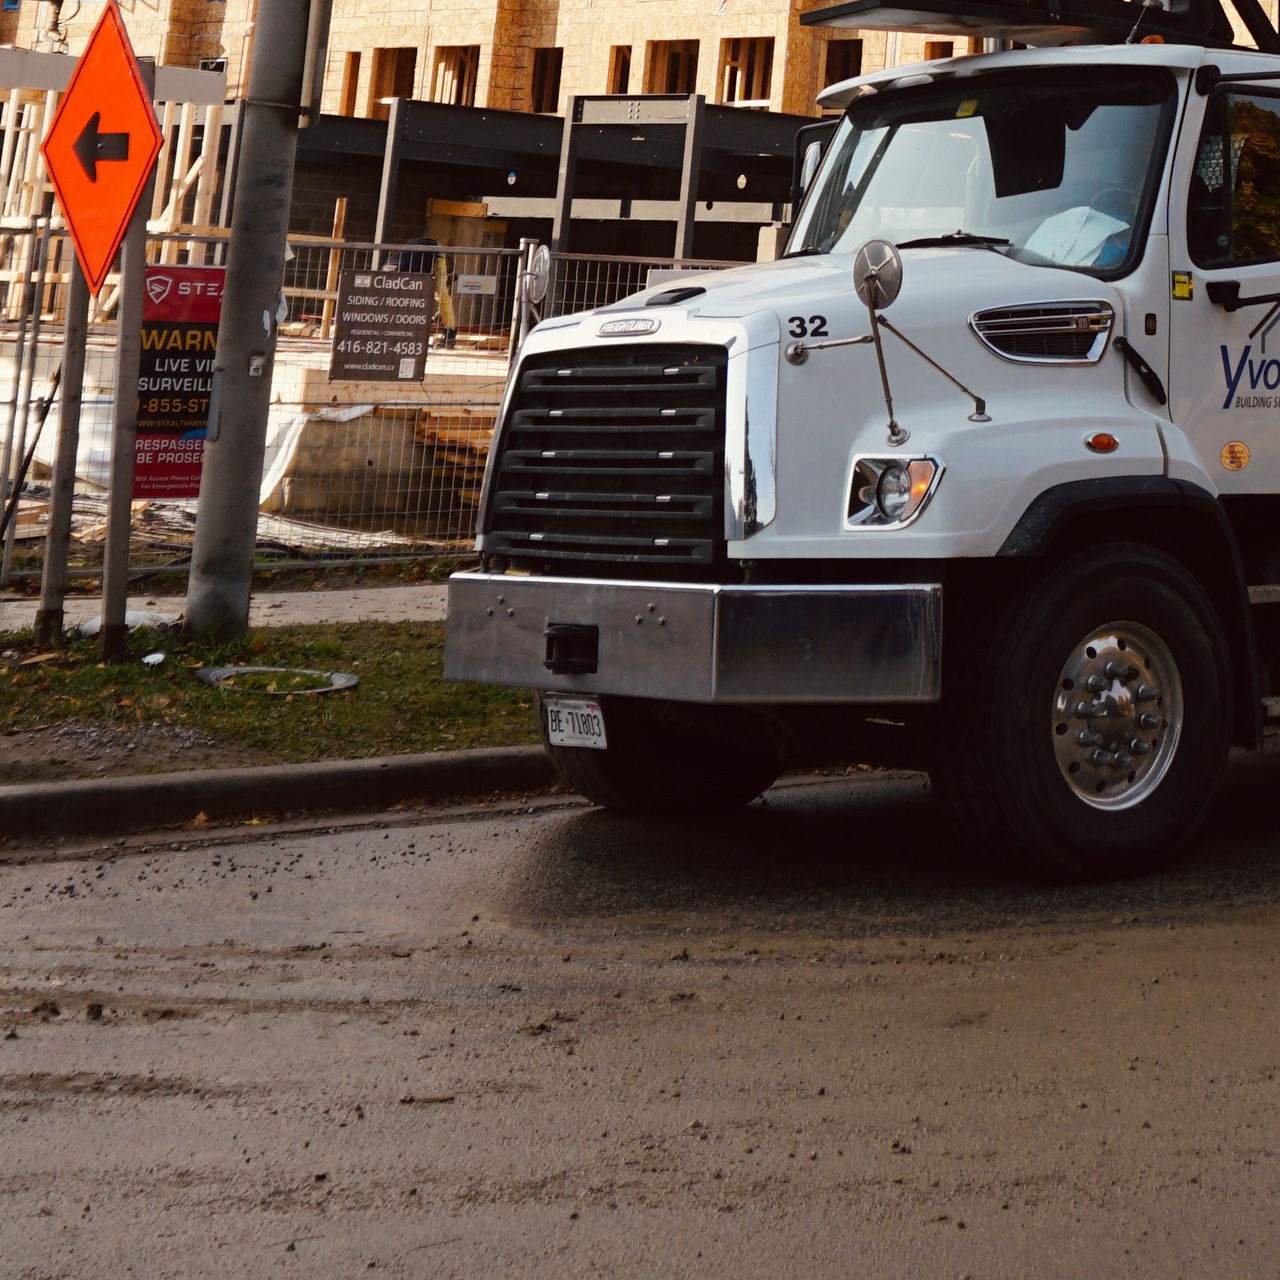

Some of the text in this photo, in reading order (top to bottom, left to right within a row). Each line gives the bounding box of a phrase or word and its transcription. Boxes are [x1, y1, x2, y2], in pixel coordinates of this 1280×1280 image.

[177, 282, 224, 296] STE
[373, 275, 423, 291] CladCan
[347, 295, 378, 306] SIDING
[386, 297, 425, 308] ROOFING
[342, 312, 389, 323] WINDOWS
[395, 314, 426, 325] DOORS
[600, 320, 653, 333] FREIGHTLINER
[788, 315, 829, 338] 32
[336, 340, 422, 356] 416-821-4583
[155, 358, 190, 372] LIVE
[343, 362, 395, 371] www.cladcan.ca
[1235, 396, 1272, 408] BUILDING
[136, 453, 153, 464] BE
[549, 709, 602, 737] BE 71803
